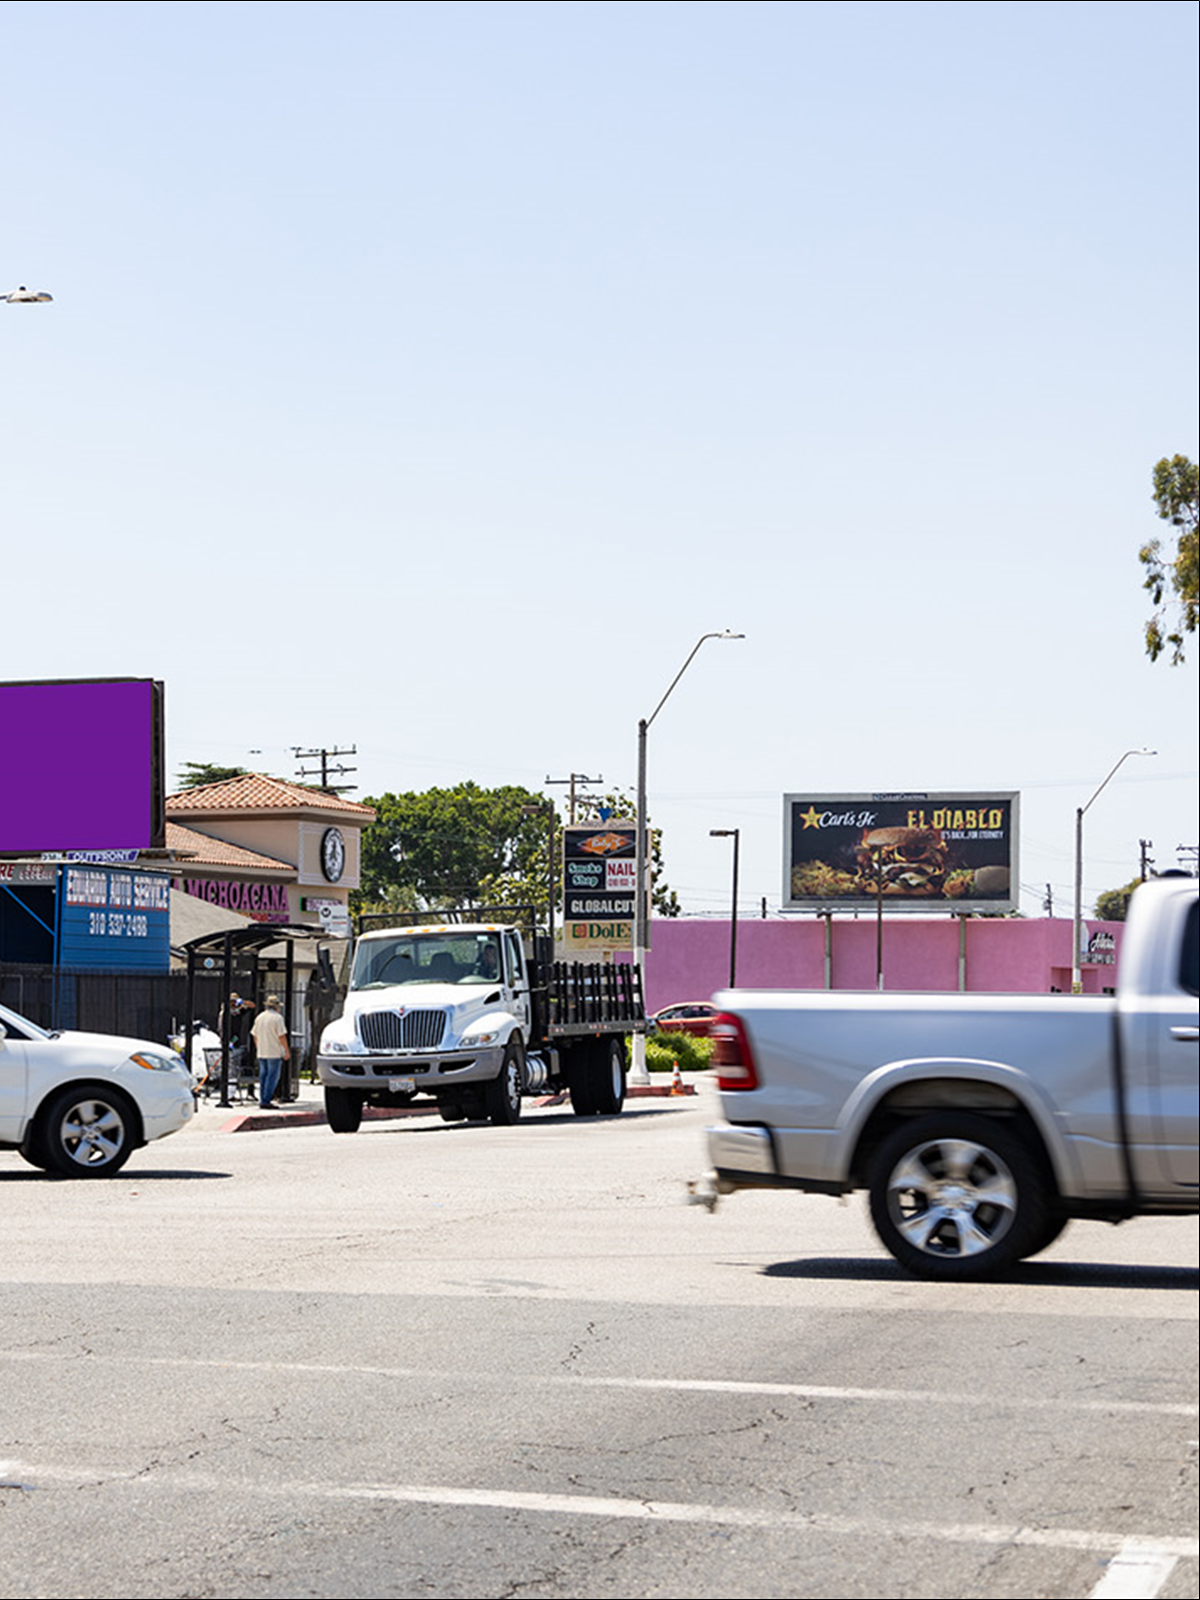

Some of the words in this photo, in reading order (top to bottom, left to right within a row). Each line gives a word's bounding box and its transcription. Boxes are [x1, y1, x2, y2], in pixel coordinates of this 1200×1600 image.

[819, 810, 856, 828] Carl's
[856, 810, 876, 828] Jr.
[906, 810, 930, 829] EL
[932, 807, 1003, 830] DIABLO
[568, 861, 602, 875] Smoke
[572, 874, 599, 887] Shop
[185, 878, 289, 912] MICHOACANA
